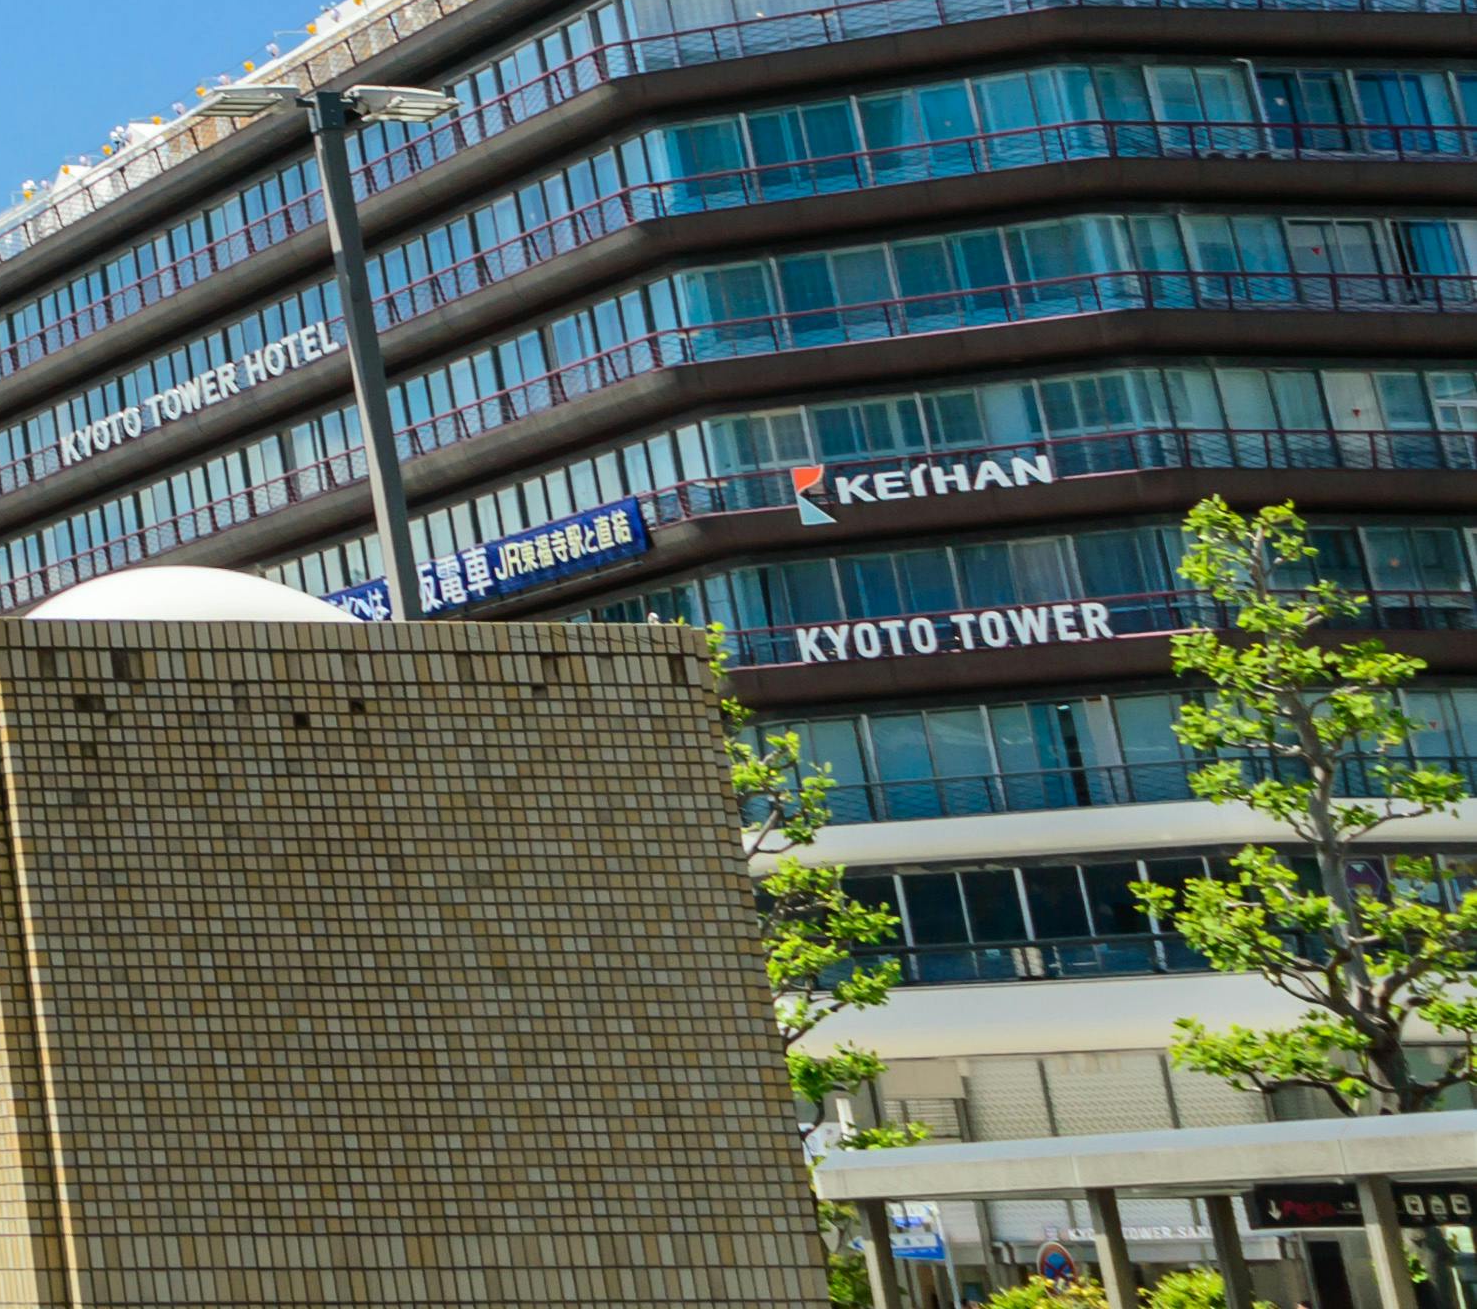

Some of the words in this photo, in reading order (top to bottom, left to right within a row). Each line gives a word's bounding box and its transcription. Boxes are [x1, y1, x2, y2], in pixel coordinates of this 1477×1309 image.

[60, 407, 142, 466] KYOTO
[144, 362, 240, 427] TOWER
[246, 321, 340, 386] HOTEL
[835, 454, 1053, 505] KEIHAN
[796, 619, 937, 663] KYOTO
[950, 602, 1114, 650] TOWER
